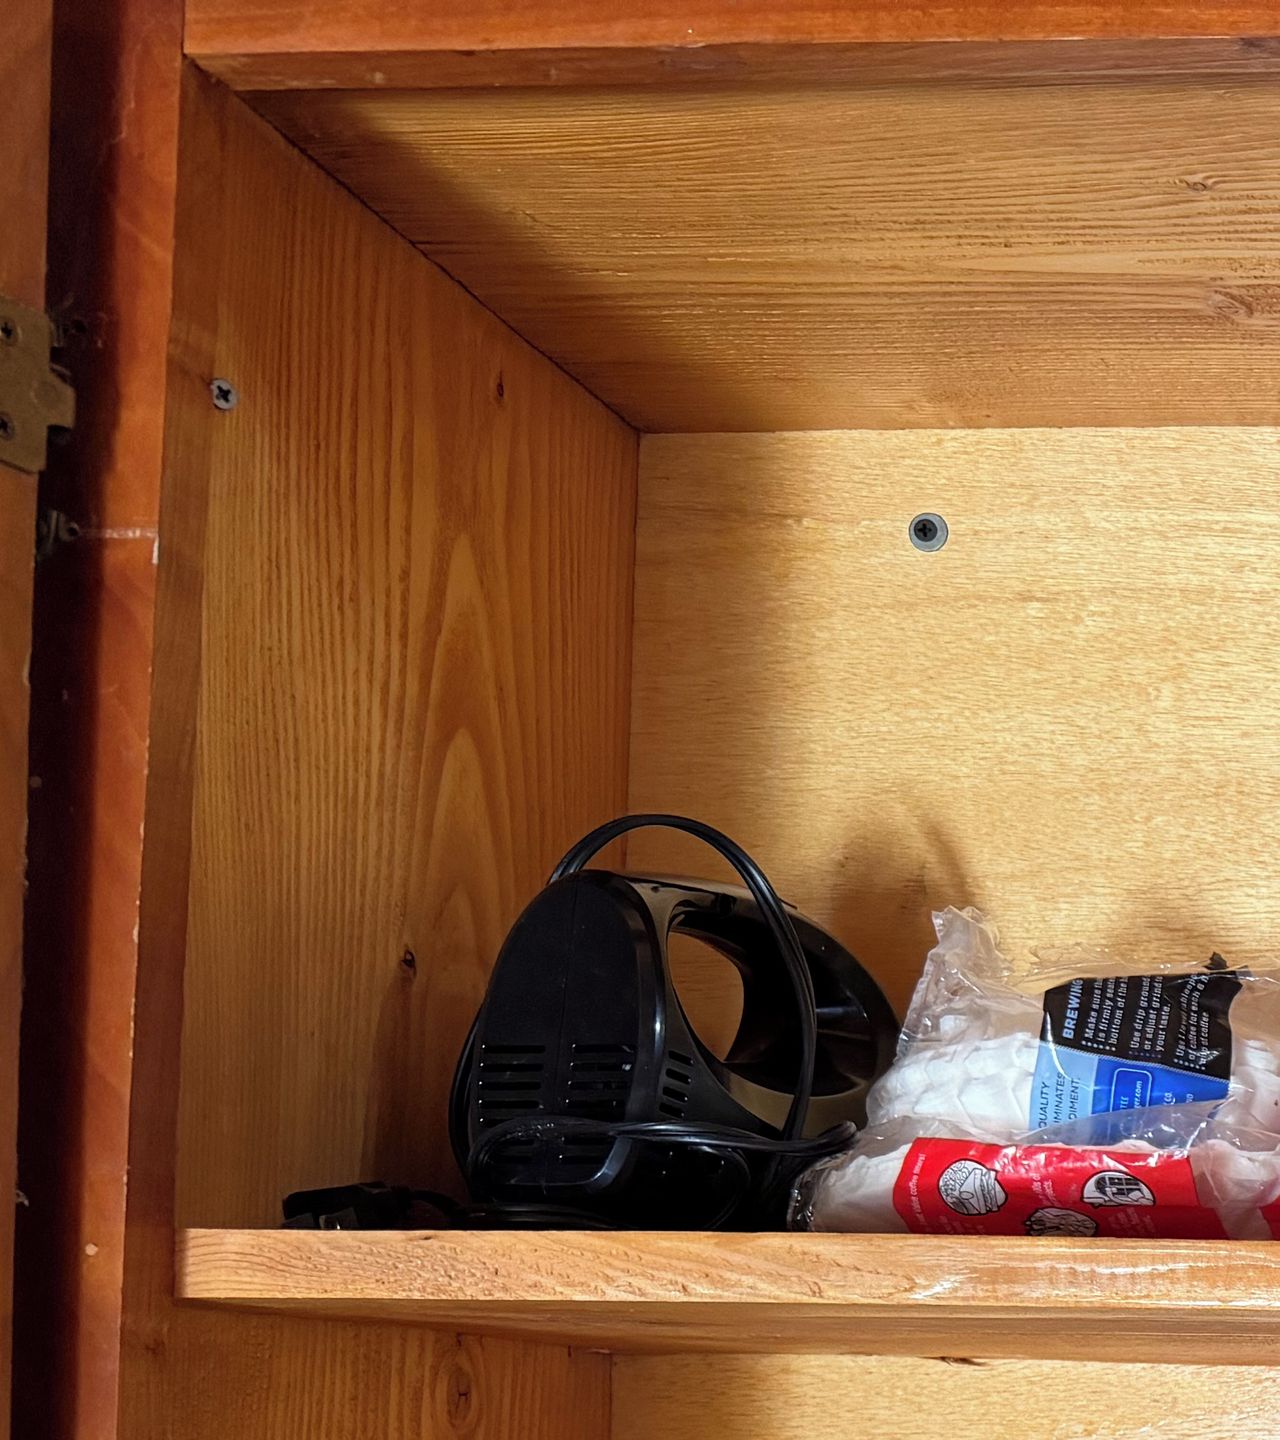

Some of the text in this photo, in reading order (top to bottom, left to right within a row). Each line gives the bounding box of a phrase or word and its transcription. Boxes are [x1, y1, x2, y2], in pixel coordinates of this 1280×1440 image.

[1117, 997, 1126, 1008] of
[1118, 982, 1128, 997] the
[1063, 979, 1084, 1039] BREWING
[1084, 1011, 1098, 1039] Make
[1092, 988, 1102, 1010] sure
[1099, 999, 1114, 1031] firmly
[1133, 1008, 1146, 1030] drip
[1145, 1009, 1158, 1039] adjust
[1108, 1009, 1124, 1045] bottom
[1130, 1031, 1141, 1049] Use
[1156, 1003, 1172, 1052] your taste.
[1175, 1039, 1186, 1057] Use
